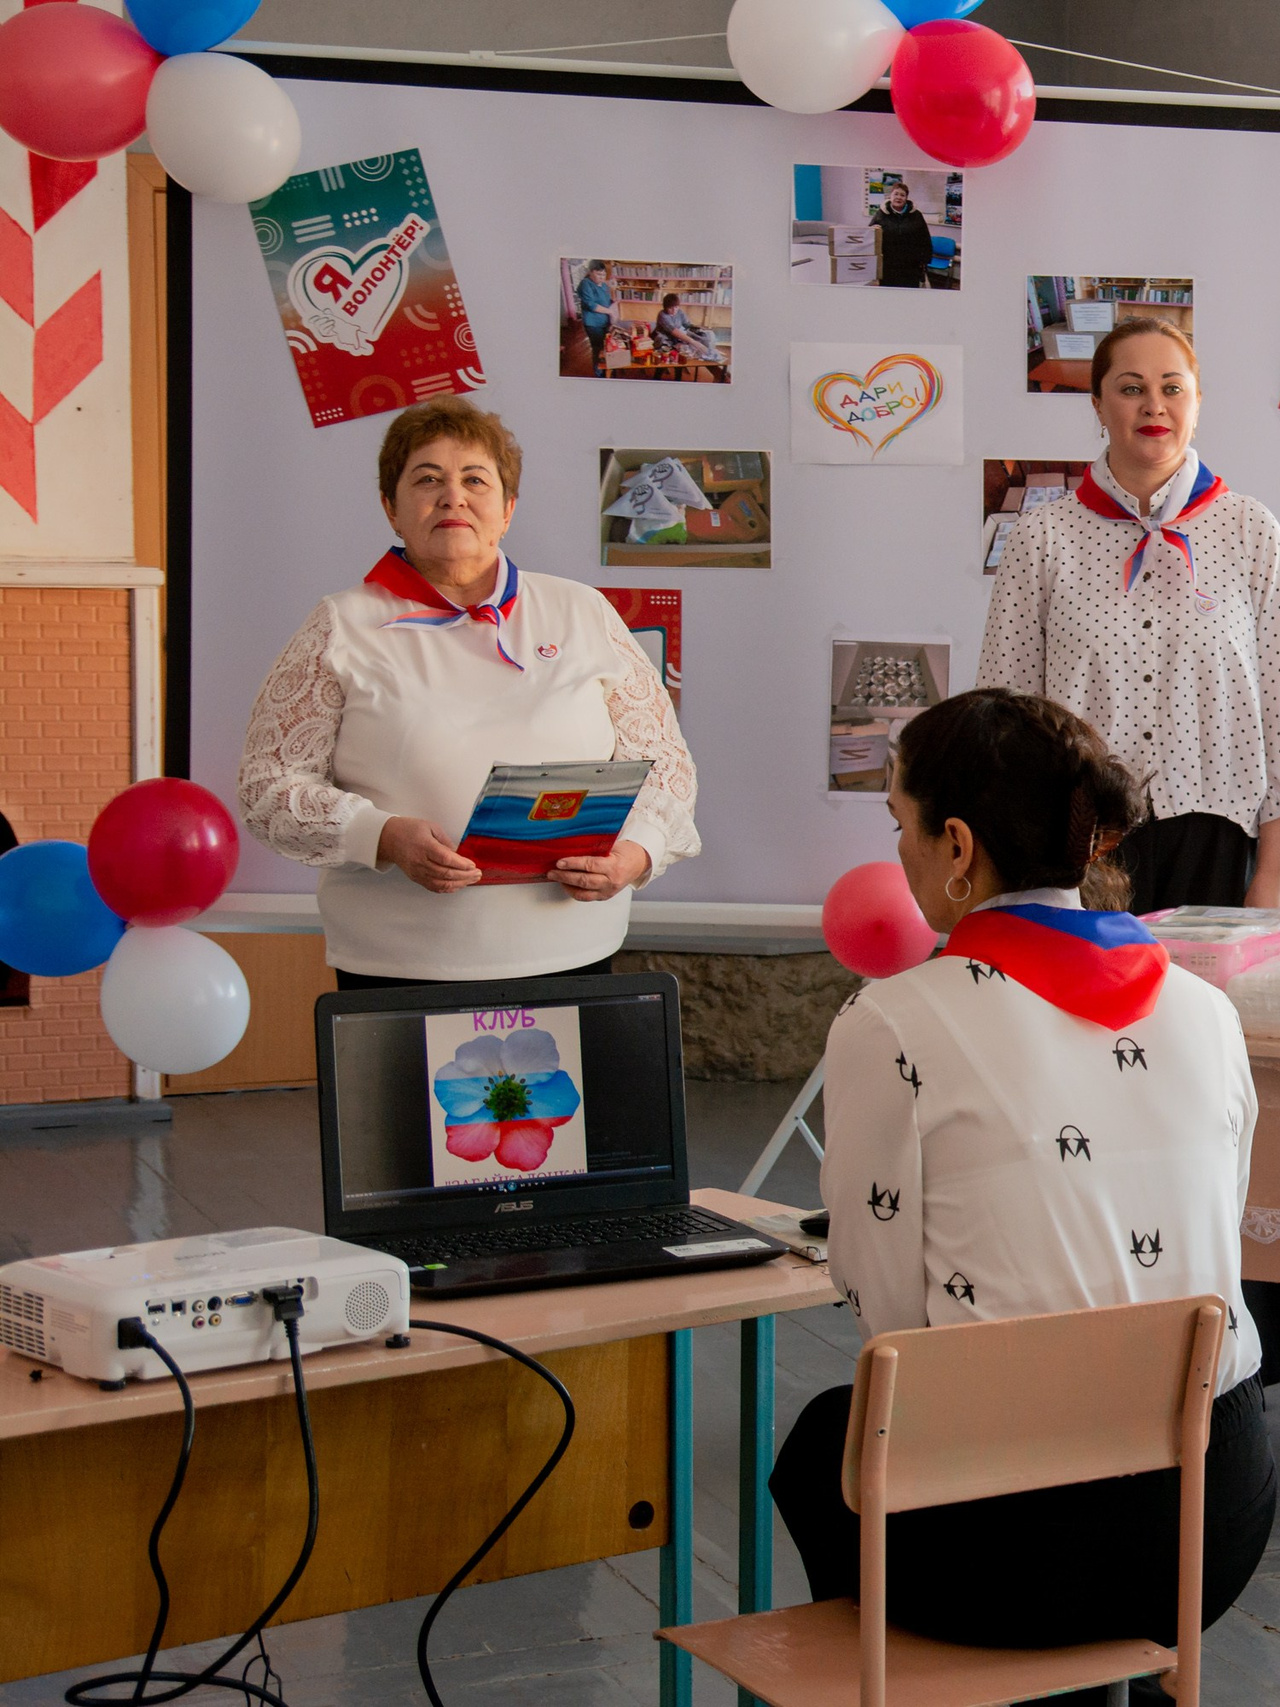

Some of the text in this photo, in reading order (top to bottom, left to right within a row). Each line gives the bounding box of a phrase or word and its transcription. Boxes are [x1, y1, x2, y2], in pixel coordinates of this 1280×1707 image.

[313, 262, 353, 304] Я
[341, 219, 424, 317] ВОЛОНТЁР!
[840, 381, 914, 409] ДАРИ
[847, 387, 924, 425] ДОБРО!
[473, 1008, 536, 1031] КЛУБ
[494, 1200, 534, 1214] ASUS
